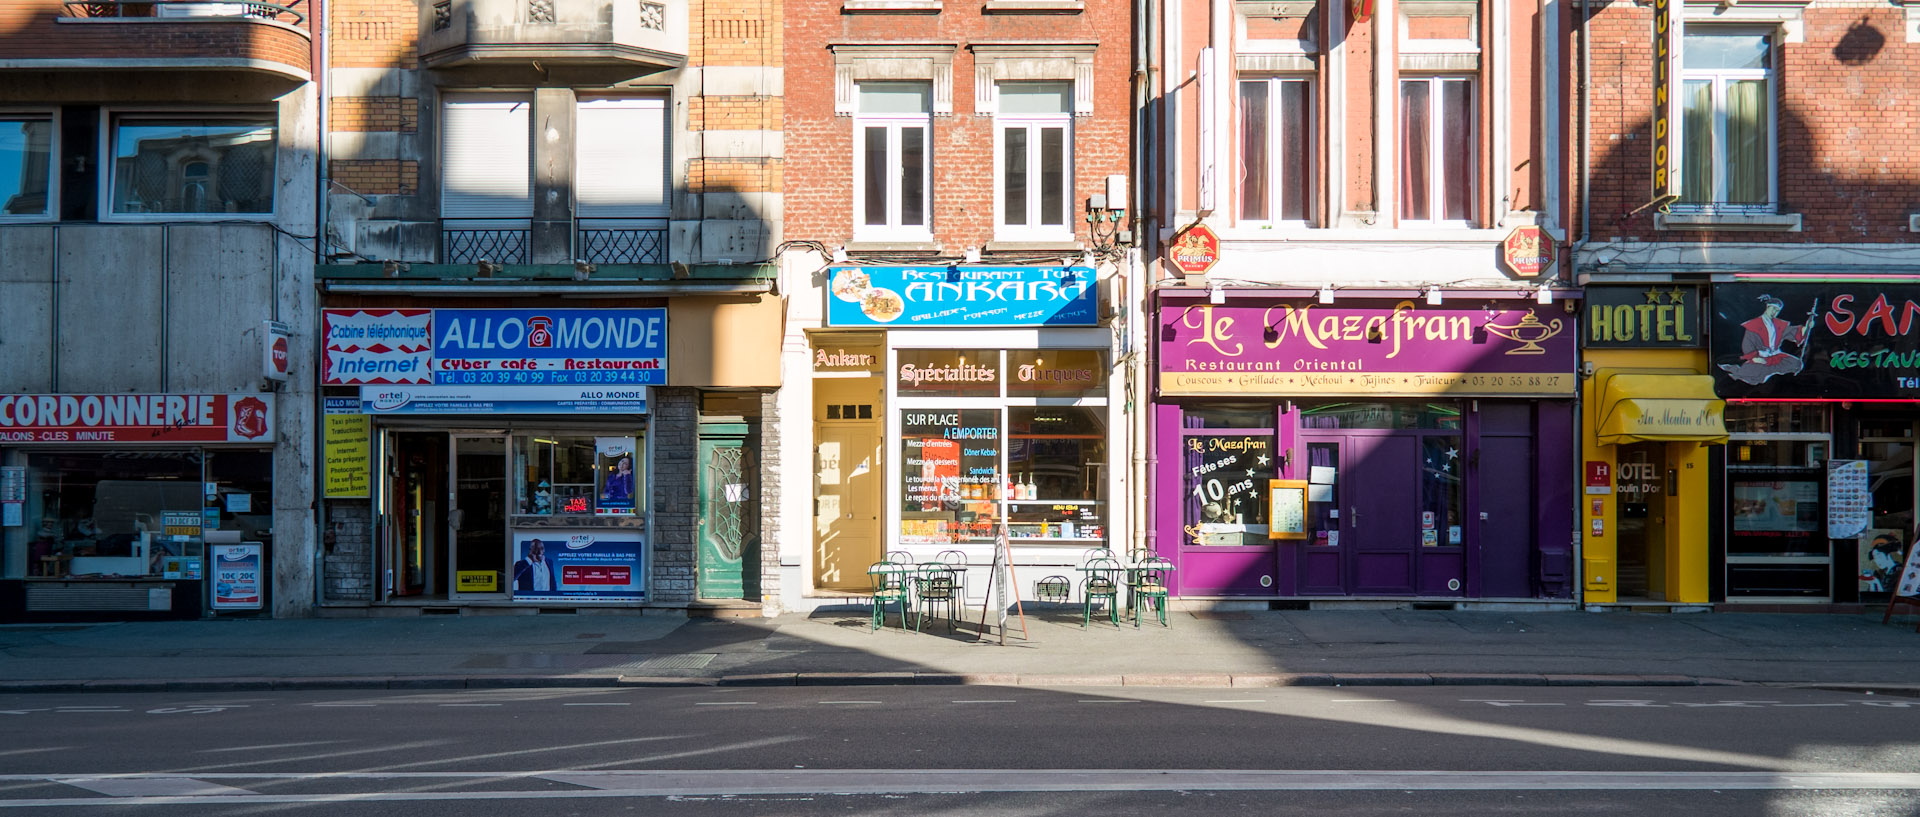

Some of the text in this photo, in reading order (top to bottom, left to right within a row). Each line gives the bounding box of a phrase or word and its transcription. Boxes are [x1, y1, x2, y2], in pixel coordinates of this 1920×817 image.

[1513, 256, 1548, 264] PRIMUS
[905, 281, 1088, 302] ANKARA
[1592, 304, 1693, 342] HOTEL
[331, 323, 426, 341] Cabine téléphonique
[440, 317, 525, 349] ALLO
[556, 317, 661, 349] MONDE
[1183, 300, 1473, 359] Le Mazafran
[338, 356, 419, 373] Internet
[441, 358, 491, 371] Cyber
[501, 358, 538, 370] café
[565, 358, 660, 370] Restaurant
[814, 349, 877, 369] Ankara
[1185, 358, 1281, 371] Restaurant
[1293, 358, 1363, 371] Oriental
[439, 372, 651, 384] Tél. 03 20 39 40 99 Fax 03 20 39 44 30
[900, 362, 1092, 387] Spécialités Turques
[1176, 375, 1223, 387] Couscous
[1238, 375, 1284, 387] Grillades
[1300, 374, 1343, 388] Méchoui
[1359, 375, 1396, 388] Tajines
[1413, 374, 1456, 387] Traiteur
[1490, 376, 1504, 387] 20
[1509, 376, 1523, 387] 55
[1528, 376, 1542, 387] 88
[1546, 376, 1560, 387] 27
[379, 391, 402, 399] ortel
[580, 391, 640, 399] ALLO MONDE
[327, 399, 345, 408] ALLO
[0, 396, 215, 426] CORDONNERIE
[1637, 408, 1654, 425] Au
[1657, 408, 1692, 426] Moulin
[345, 417, 363, 425] phone
[907, 413, 959, 426] SUR PLACE
[0, 431, 115, 441] ALONS MINUTE
[944, 428, 998, 440] A EMPORTER
[907, 439, 953, 448] Mezze d'entrées
[1188, 436, 1267, 454] Le Mazafran
[964, 448, 997, 457] Döner Kebab
[343, 455, 367, 464] prépayer
[907, 457, 925, 466] Mezze
[935, 457, 958, 466] desserts
[1192, 454, 1237, 477] Fête ses
[331, 466, 363, 474] Photocopies
[1596, 465, 1608, 476] H
[1616, 463, 1662, 480] HOTEL
[906, 475, 913, 483] Le
[980, 475, 990, 483] des
[908, 484, 918, 492] Les
[1193, 478, 1253, 506] 10 ans
[1642, 484, 1661, 493] D'or
[570, 497, 587, 506] TAXI
[905, 494, 913, 502] Le
[913, 495, 928, 503] repas
[929, 494, 938, 502] du
[564, 504, 588, 513] PHONE
[221, 572, 254, 580] 10€ 20€
